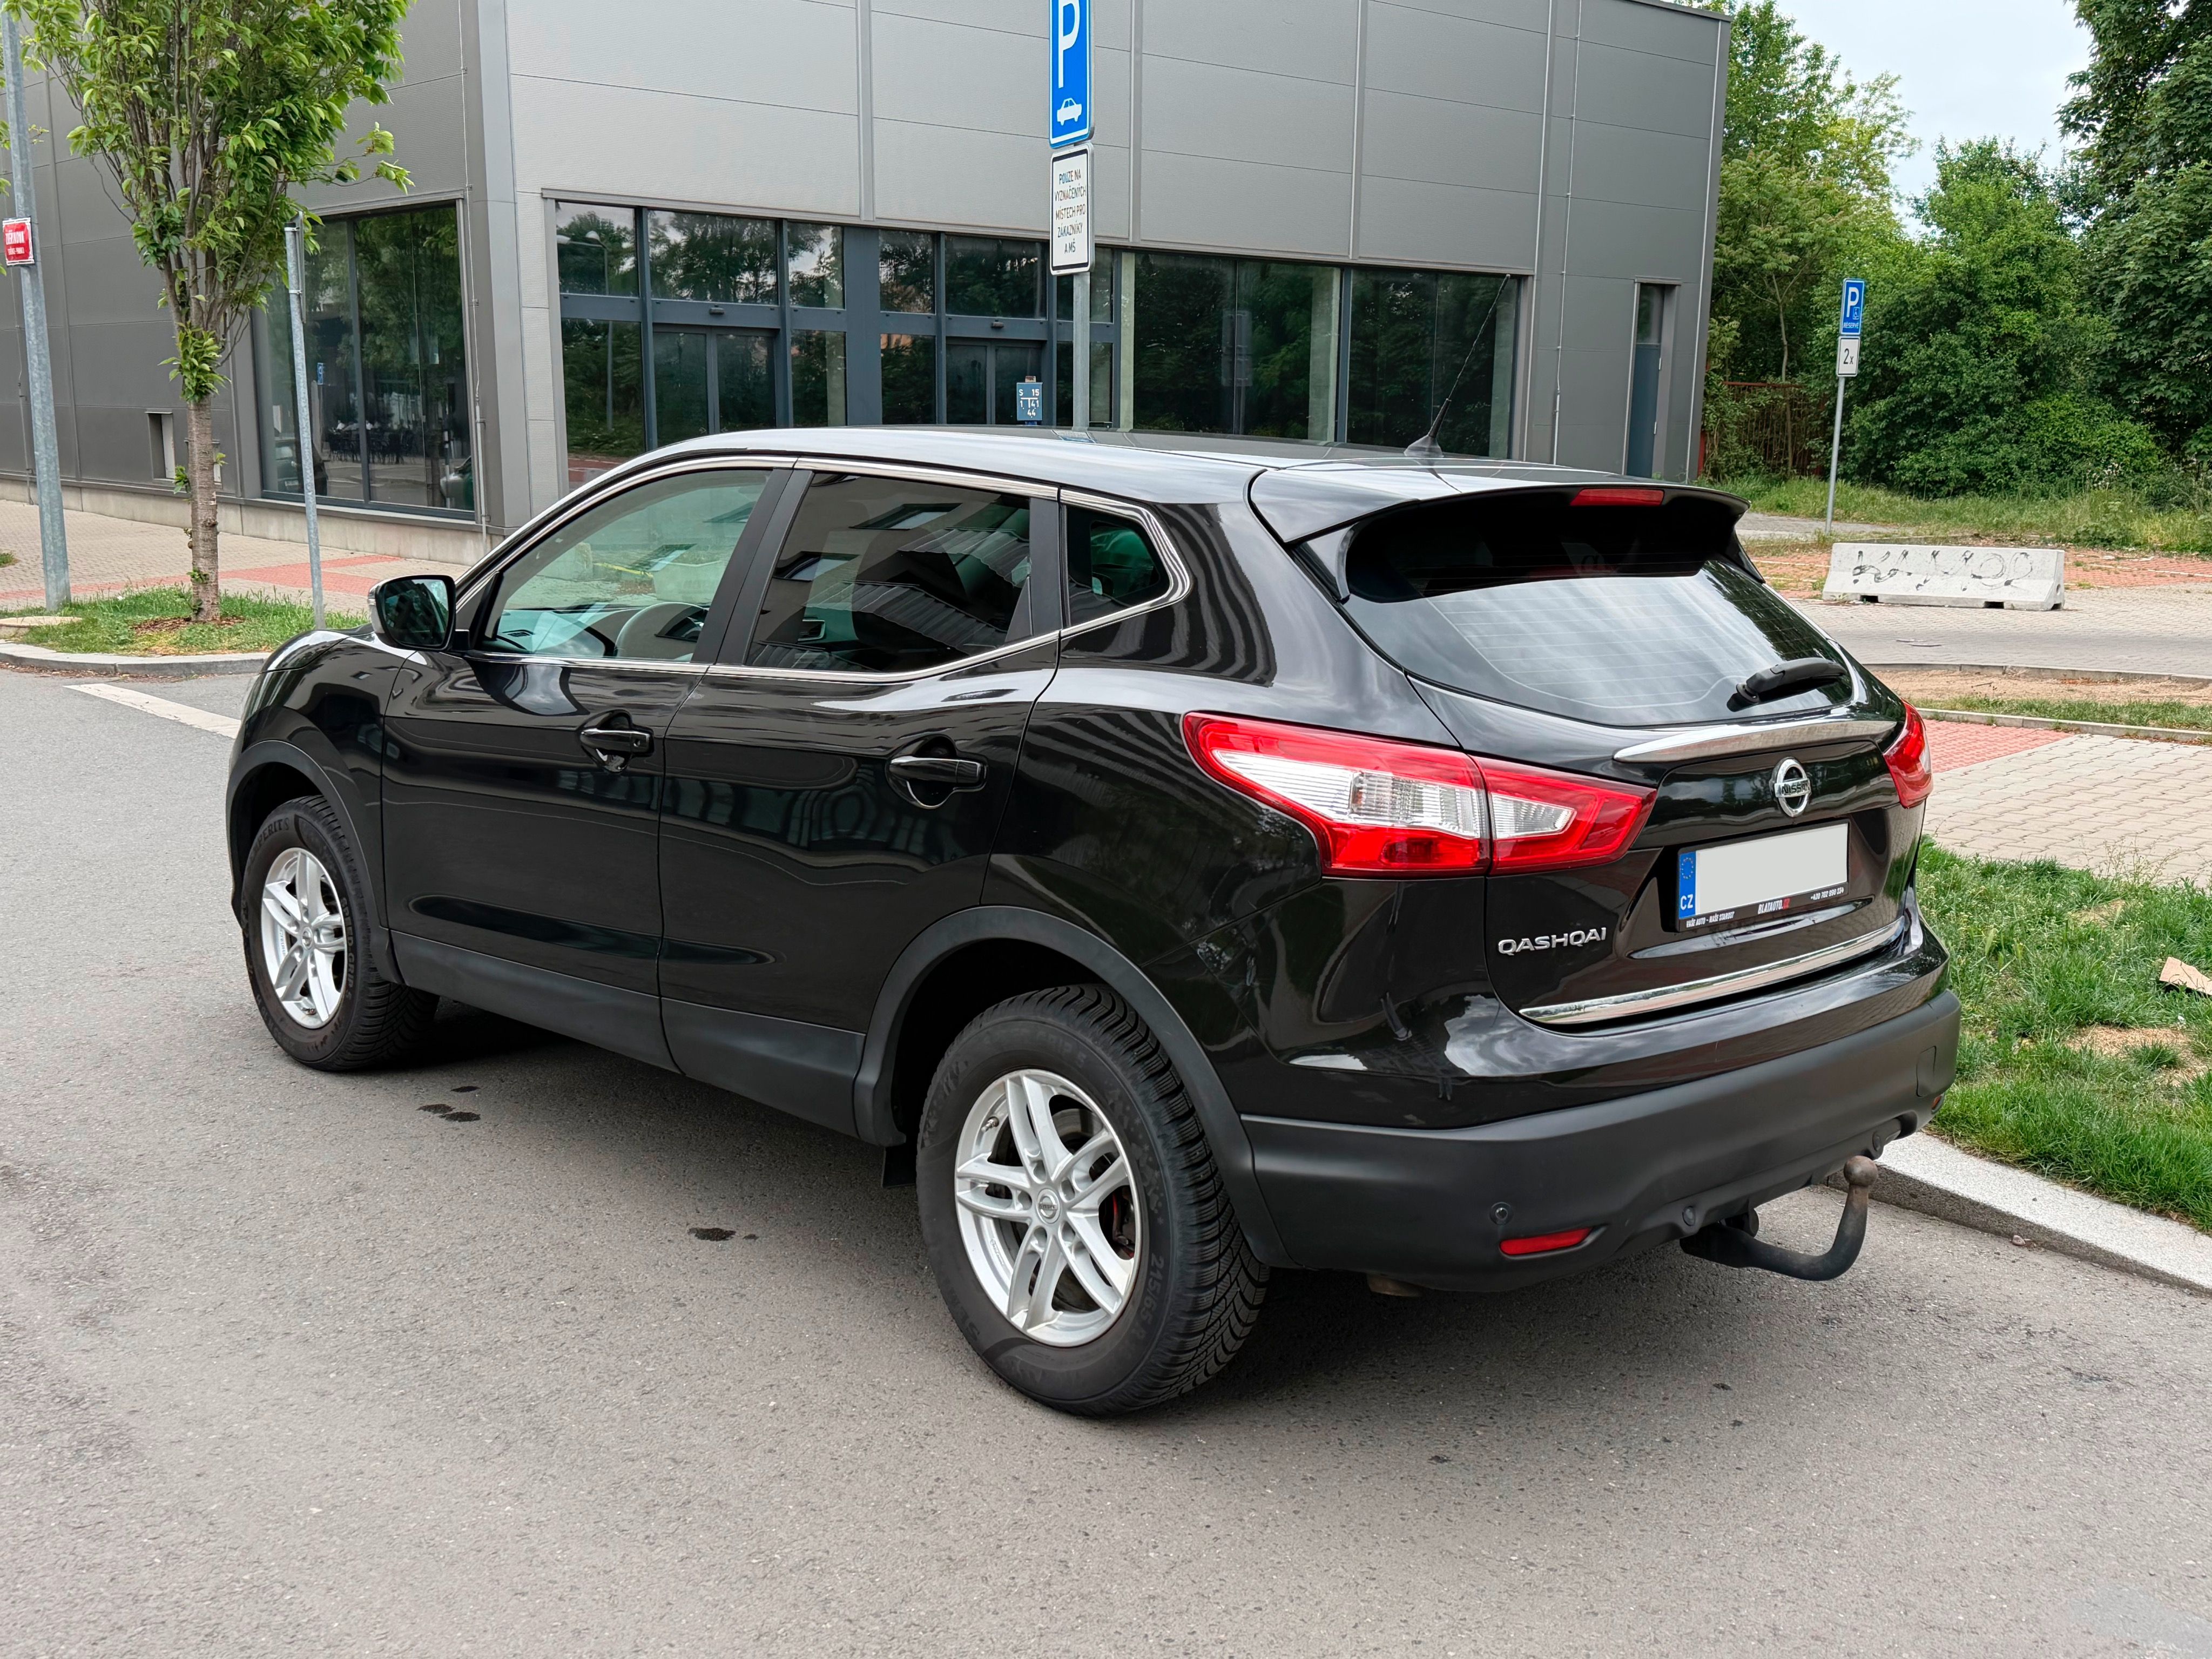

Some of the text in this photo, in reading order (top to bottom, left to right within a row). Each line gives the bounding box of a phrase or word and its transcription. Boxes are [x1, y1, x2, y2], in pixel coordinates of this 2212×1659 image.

[1058, 0, 1081, 89] P
[1059, 168, 1081, 185] POUZE NA
[1055, 183, 1086, 201] VYZNAČENÝCH
[1056, 204, 1086, 220] MÍSTECH PRO
[1057, 220, 1083, 238] ZÁKAZNÍKY
[1064, 238, 1076, 254] A MŠ
[1846, 287, 1859, 318] P
[1843, 348, 1854, 365] 2x
[1782, 781, 1810, 794] NISSAN
[1680, 894, 1694, 911] CZ
[1696, 917, 1705, 926] AUTO
[1498, 927, 1607, 956] QASHQAI
[1141, 1252, 1164, 1323] 215/65
